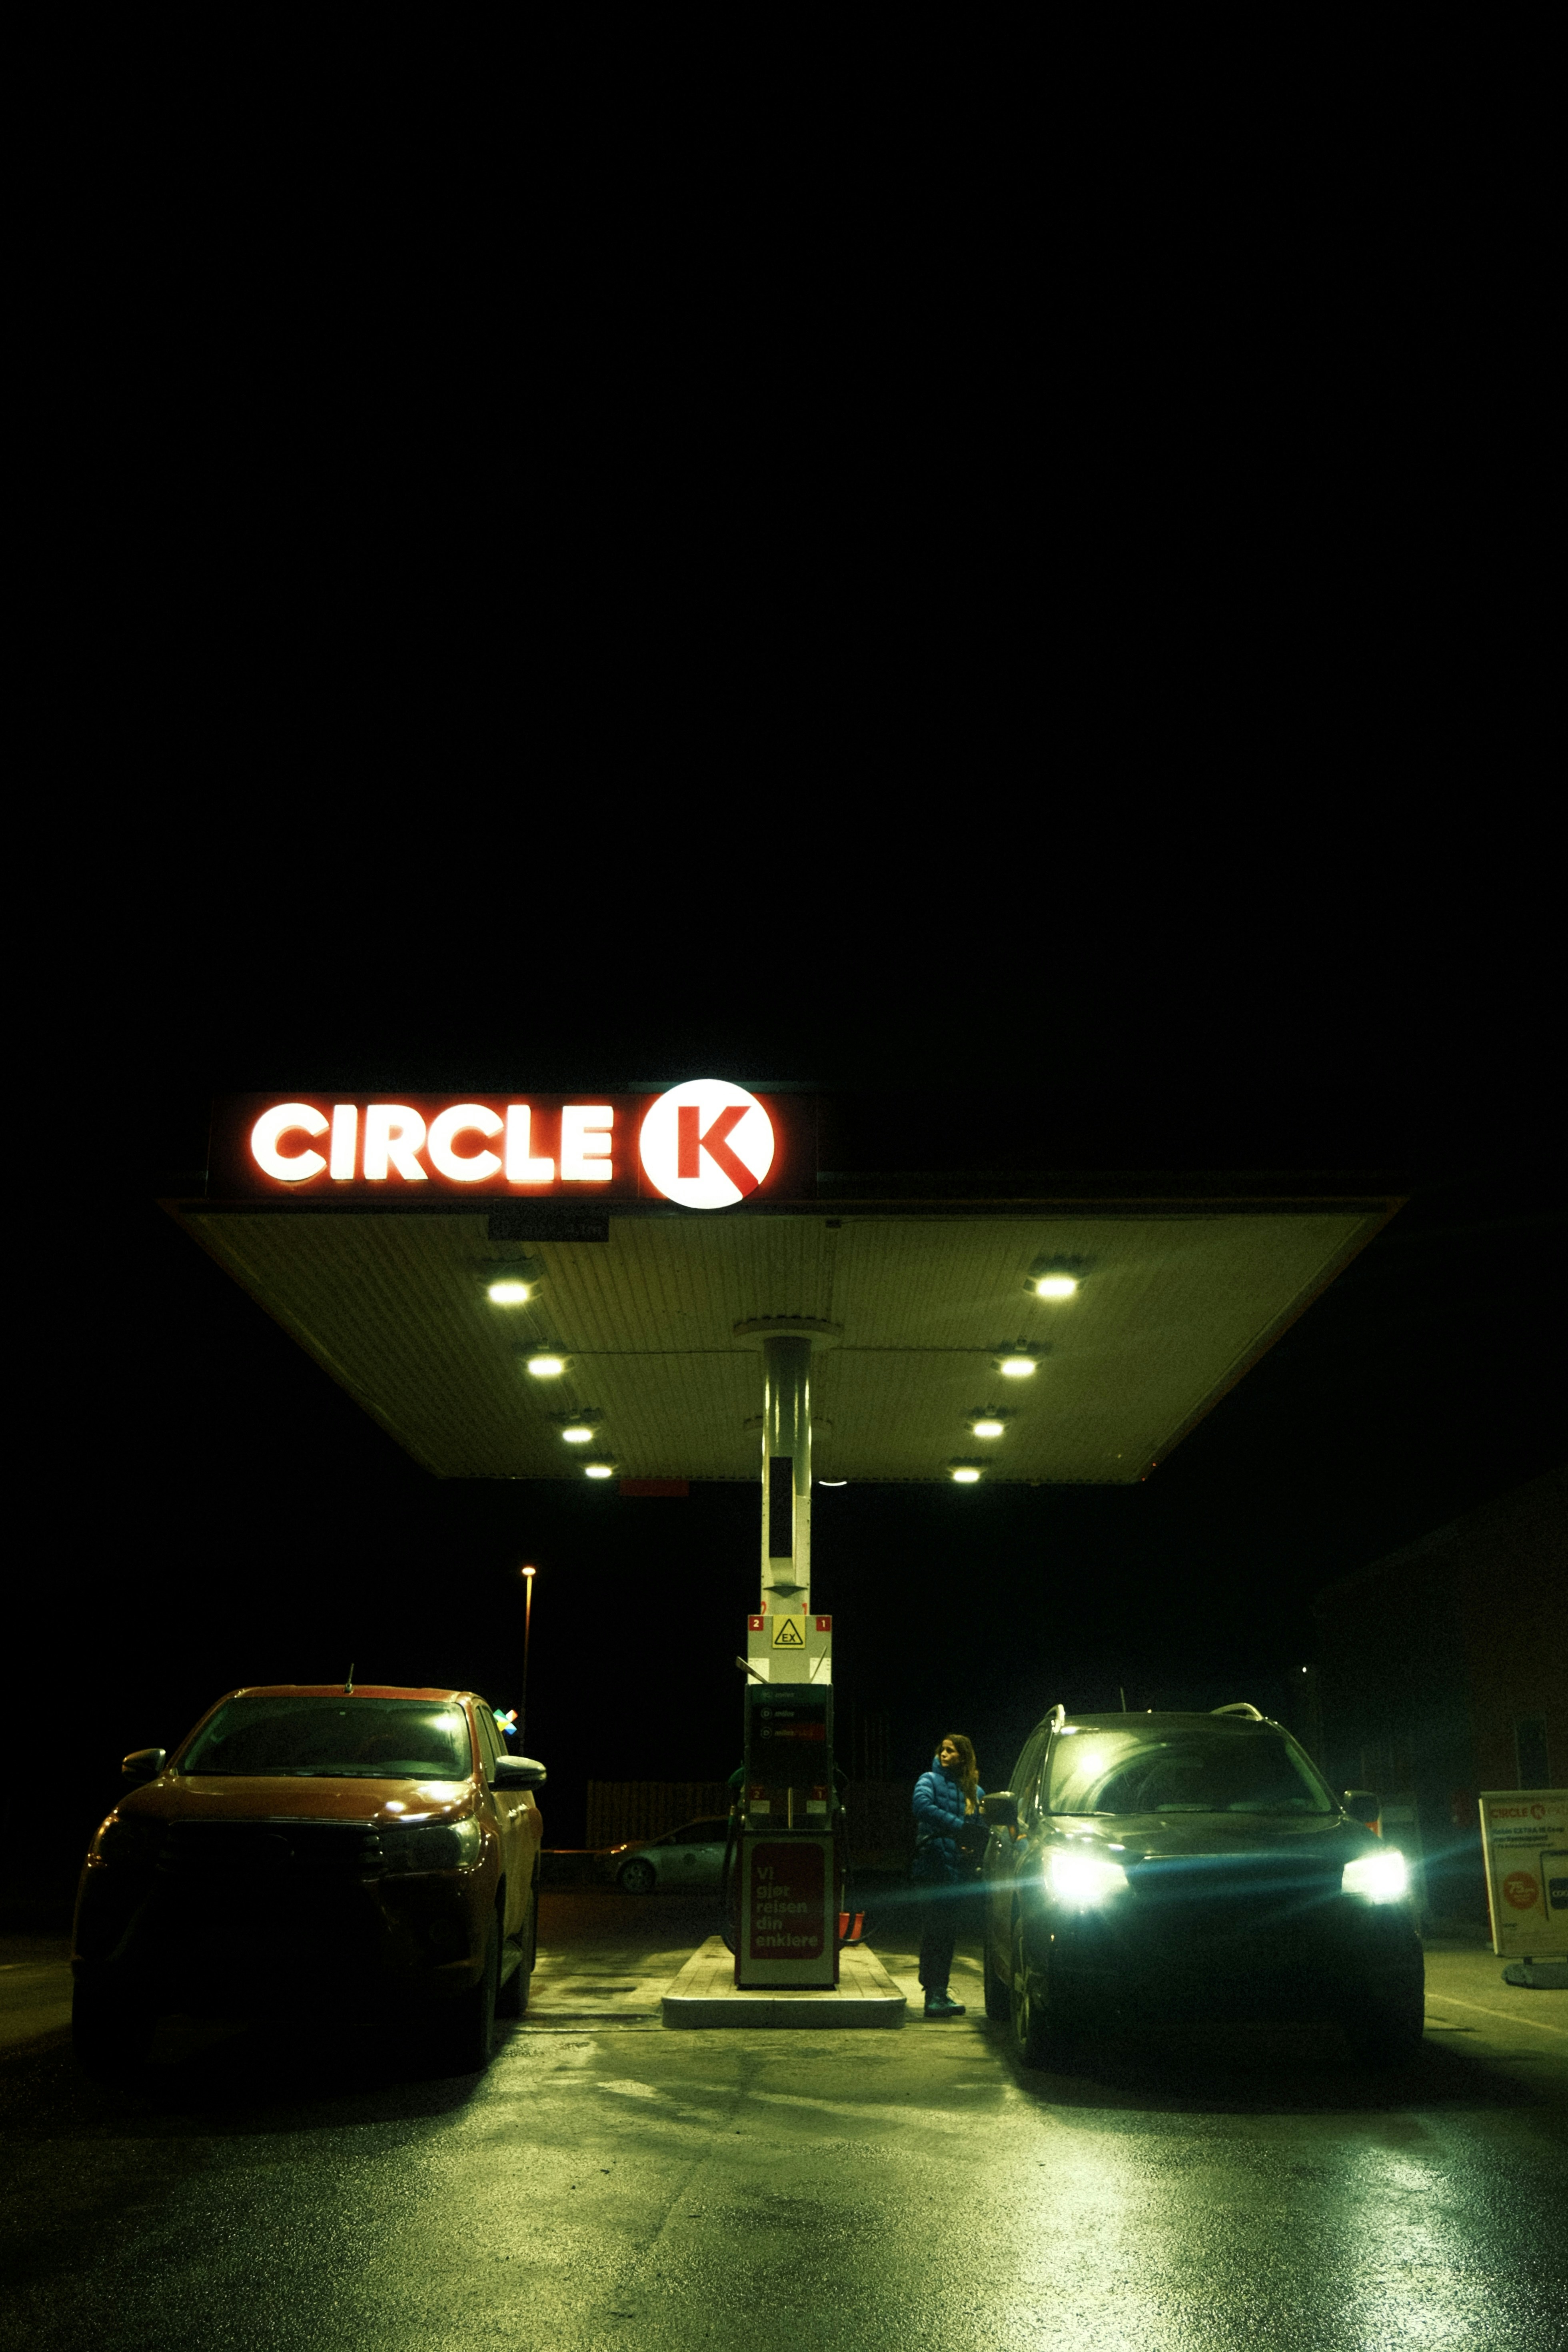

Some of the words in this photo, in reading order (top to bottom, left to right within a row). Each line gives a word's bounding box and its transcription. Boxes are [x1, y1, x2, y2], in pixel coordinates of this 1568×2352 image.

[250, 1102, 615, 1182] CIRCLE
[677, 1105, 759, 1200] K
[782, 1633, 796, 1642] EX
[754, 1790, 760, 1799] 2
[1490, 1807, 1528, 1819] CIRCLE
[757, 1867, 774, 1880] Vi
[755, 1883, 790, 1899] gjør
[756, 1900, 808, 1913] reisen
[756, 1917, 783, 1930] din
[755, 1934, 819, 1947] enklere
